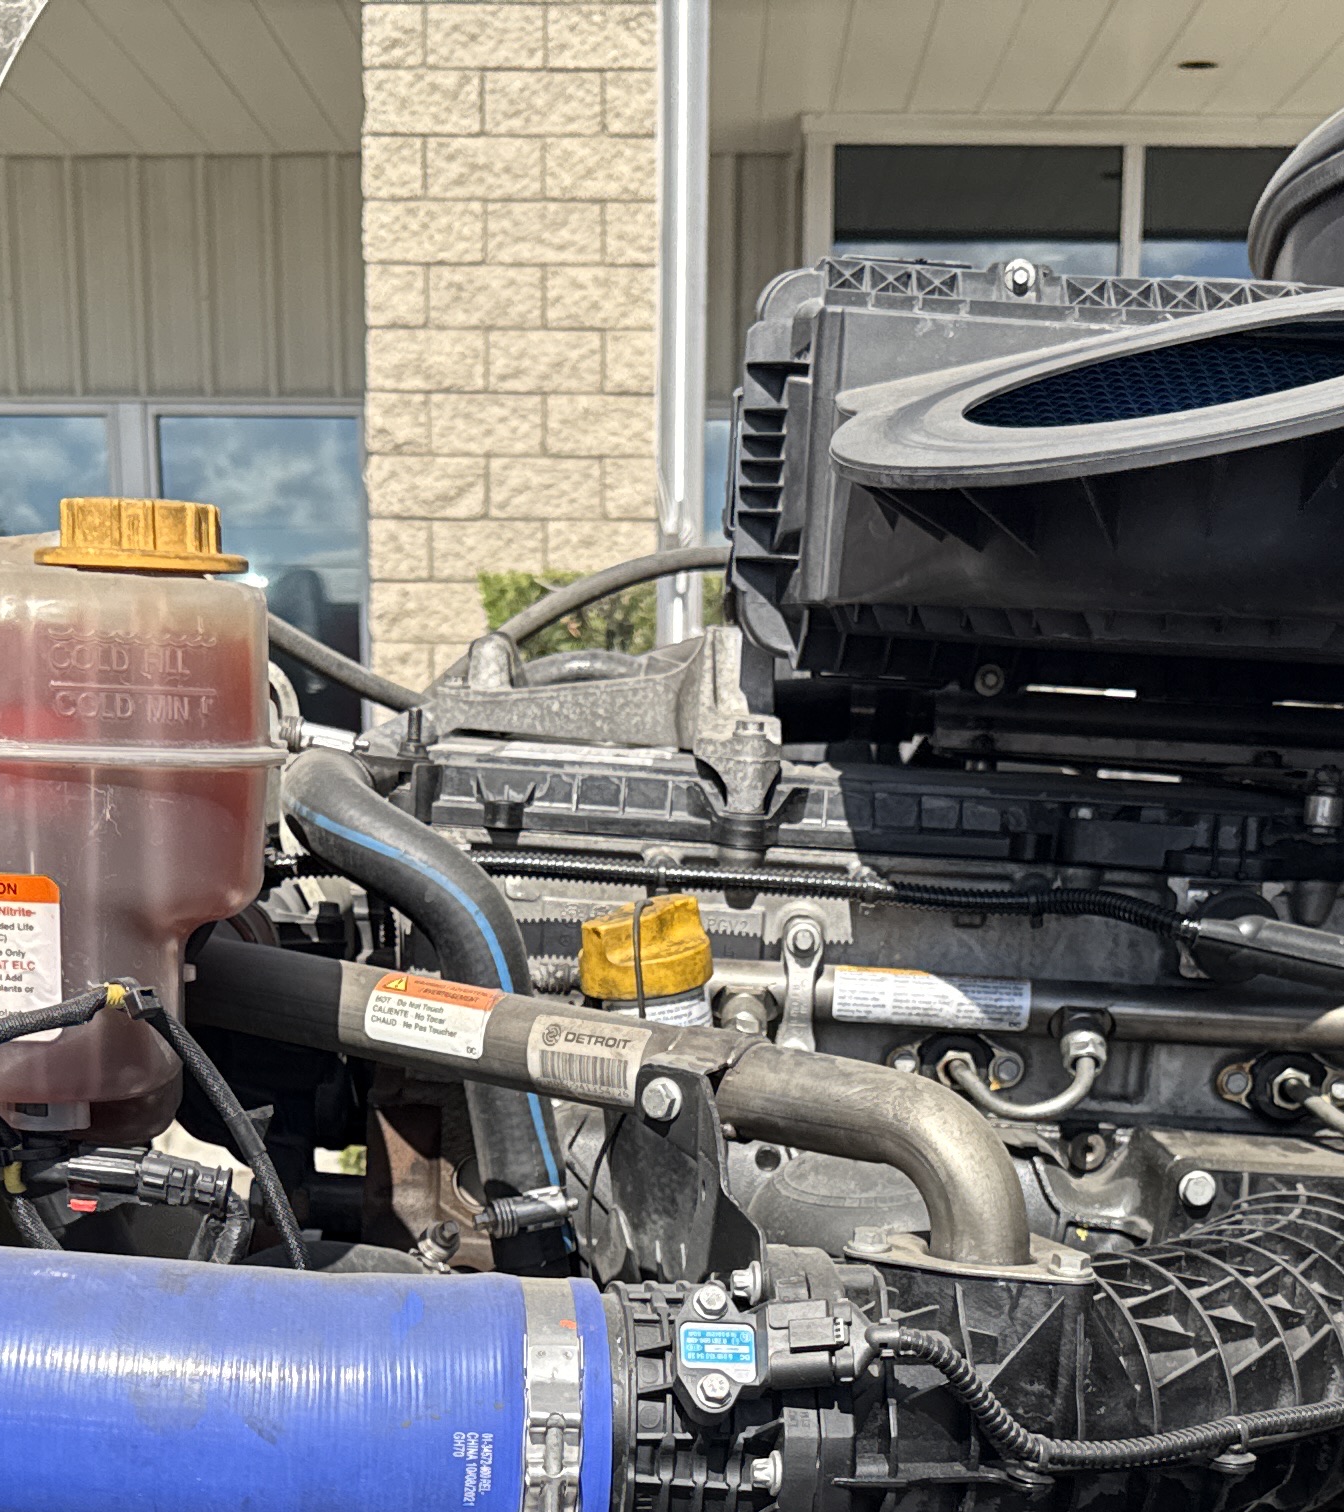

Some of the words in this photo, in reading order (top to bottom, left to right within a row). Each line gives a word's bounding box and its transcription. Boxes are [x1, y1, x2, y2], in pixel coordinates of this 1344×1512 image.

[50, 642, 129, 671] COLD
[56, 692, 133, 718] COLD
[147, 695, 189, 721] MIN
[18, 923, 34, 931] Life
[6, 949, 26, 959] Only
[12, 961, 36, 971] ELC
[373, 1005, 409, 1018] CALIENTE
[415, 1013, 425, 1021] No
[375, 995, 392, 1003] HOT
[397, 999, 407, 1007] Do
[409, 1001, 421, 1009] Not
[423, 1003, 444, 1013] Touch
[371, 1015, 397, 1026] CHAUD
[403, 1021, 412, 1029] Ne
[414, 1024, 427, 1032] Pas
[429, 1026, 457, 1037] Toucher
[564, 1032, 632, 1049] DETROIT
[452, 1431, 466, 1458] GH70
[466, 1432, 479, 1460] CHINA
